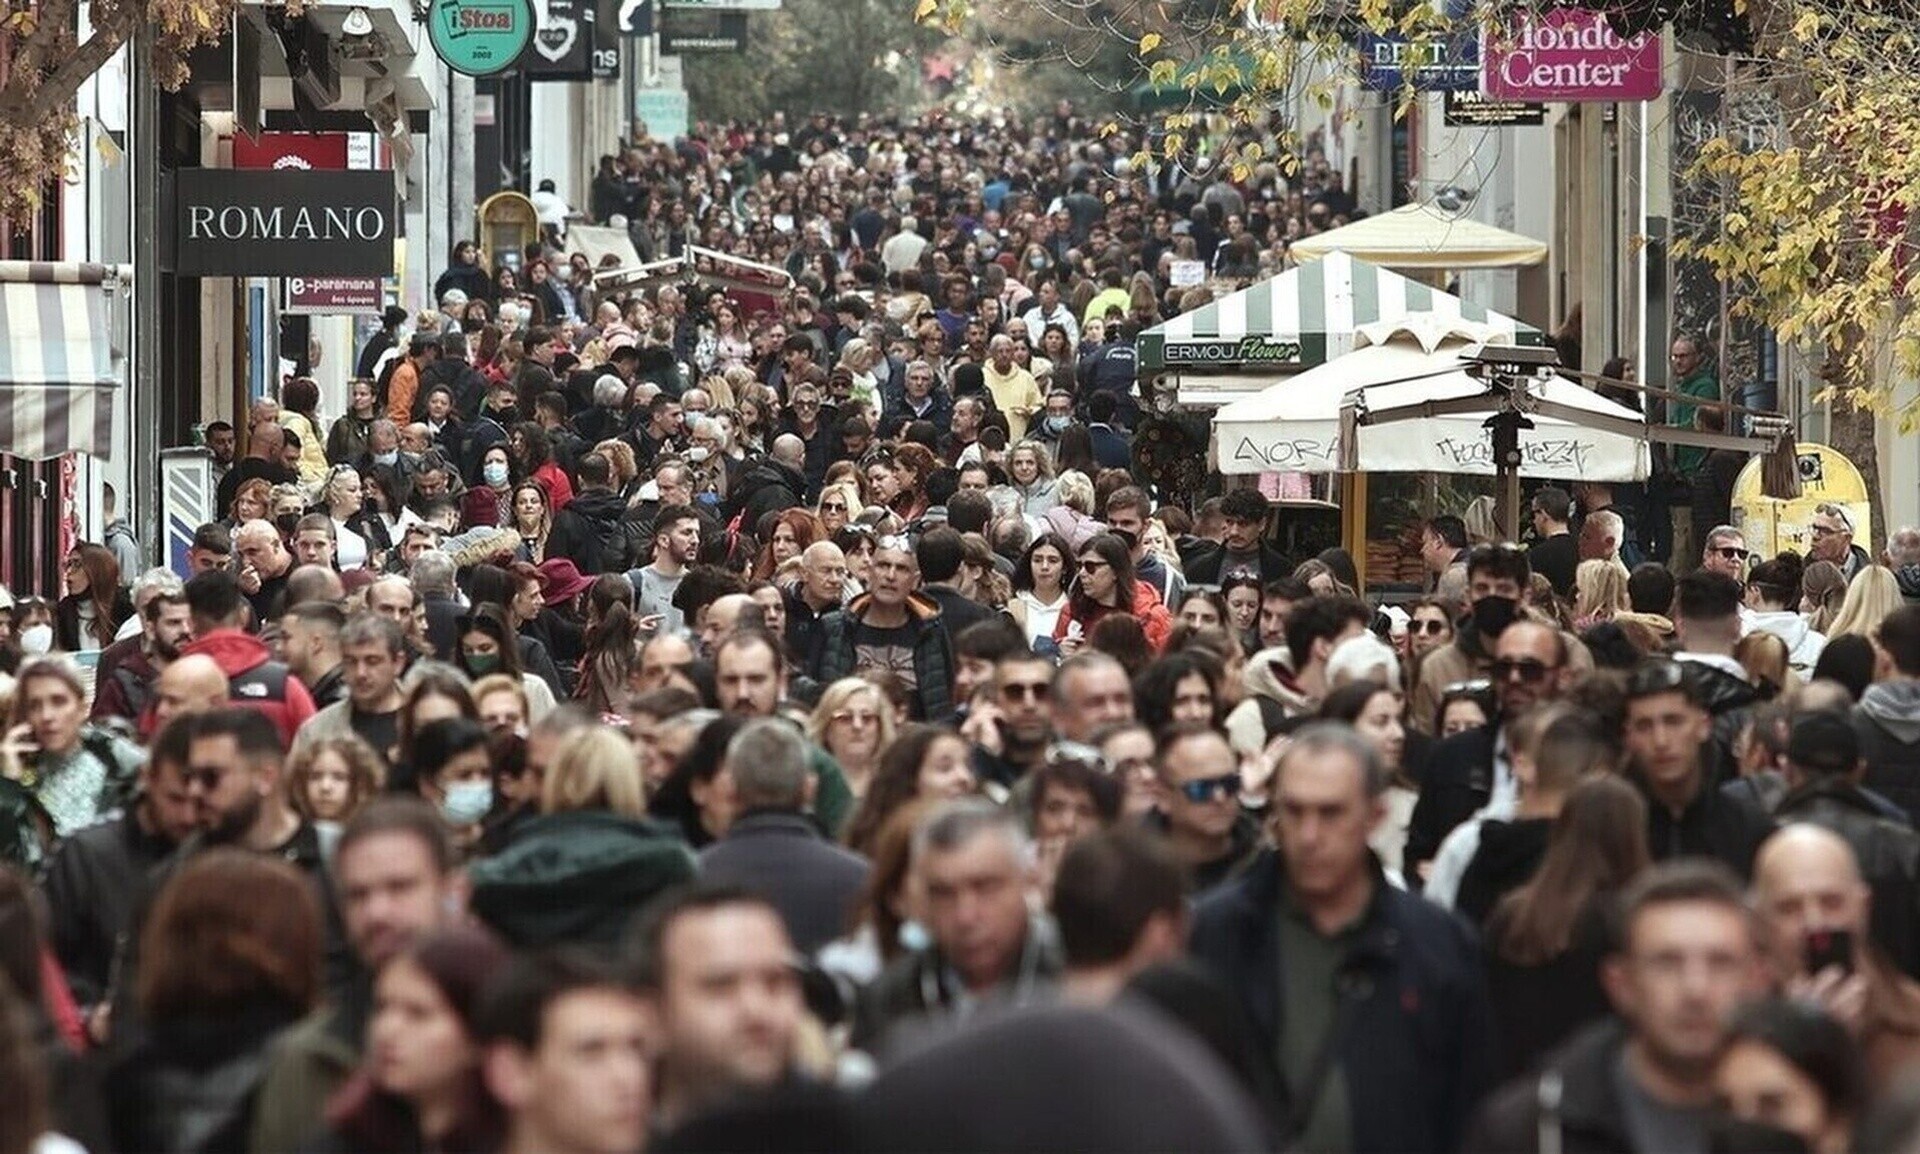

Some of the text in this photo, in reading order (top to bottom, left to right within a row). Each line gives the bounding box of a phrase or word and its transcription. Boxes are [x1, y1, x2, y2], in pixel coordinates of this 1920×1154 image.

[452, 10, 509, 28] iStoa
[1501, 51, 1631, 87] Center
[189, 206, 384, 240] ROMANO
[1166, 337, 1297, 359] ERMOU Flower
